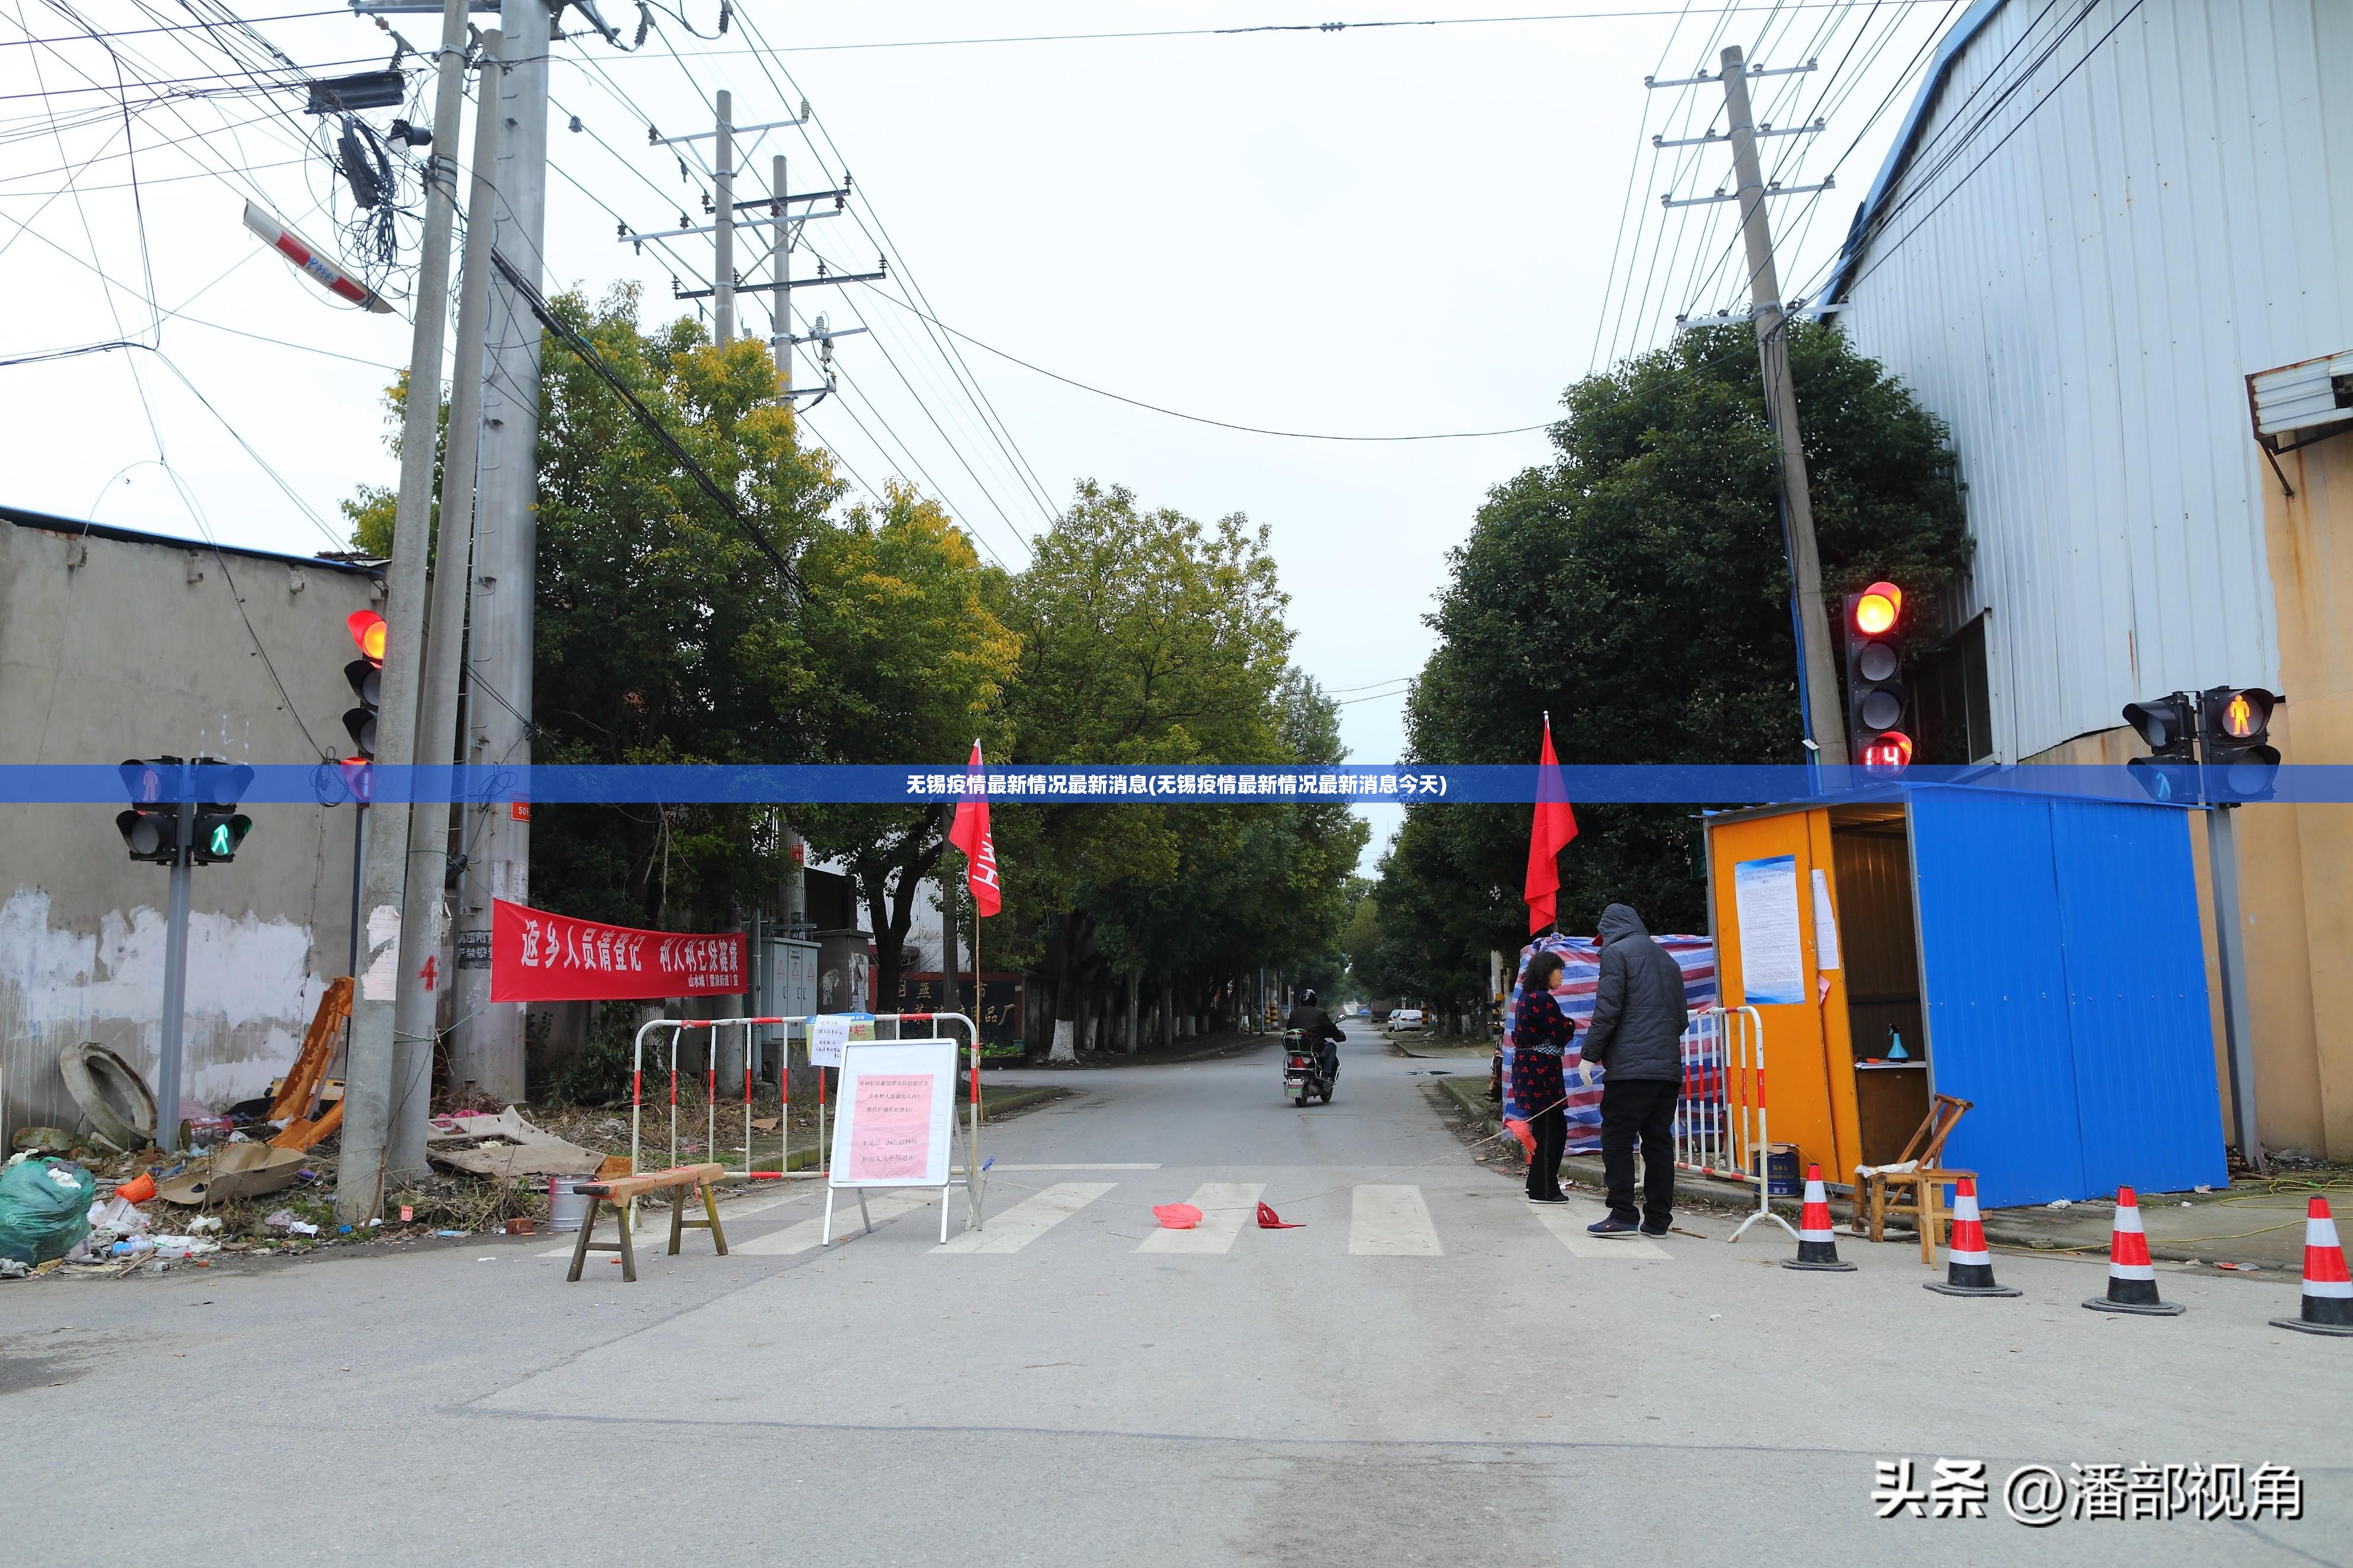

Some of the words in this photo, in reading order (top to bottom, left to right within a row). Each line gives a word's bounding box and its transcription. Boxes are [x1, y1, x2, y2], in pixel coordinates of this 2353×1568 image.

[1866, 746, 1899, 771] 14
[521, 919, 647, 972] 返乡人员请登记
[660, 937, 738, 972] 利人利己保健康
[417, 955, 438, 991] 4
